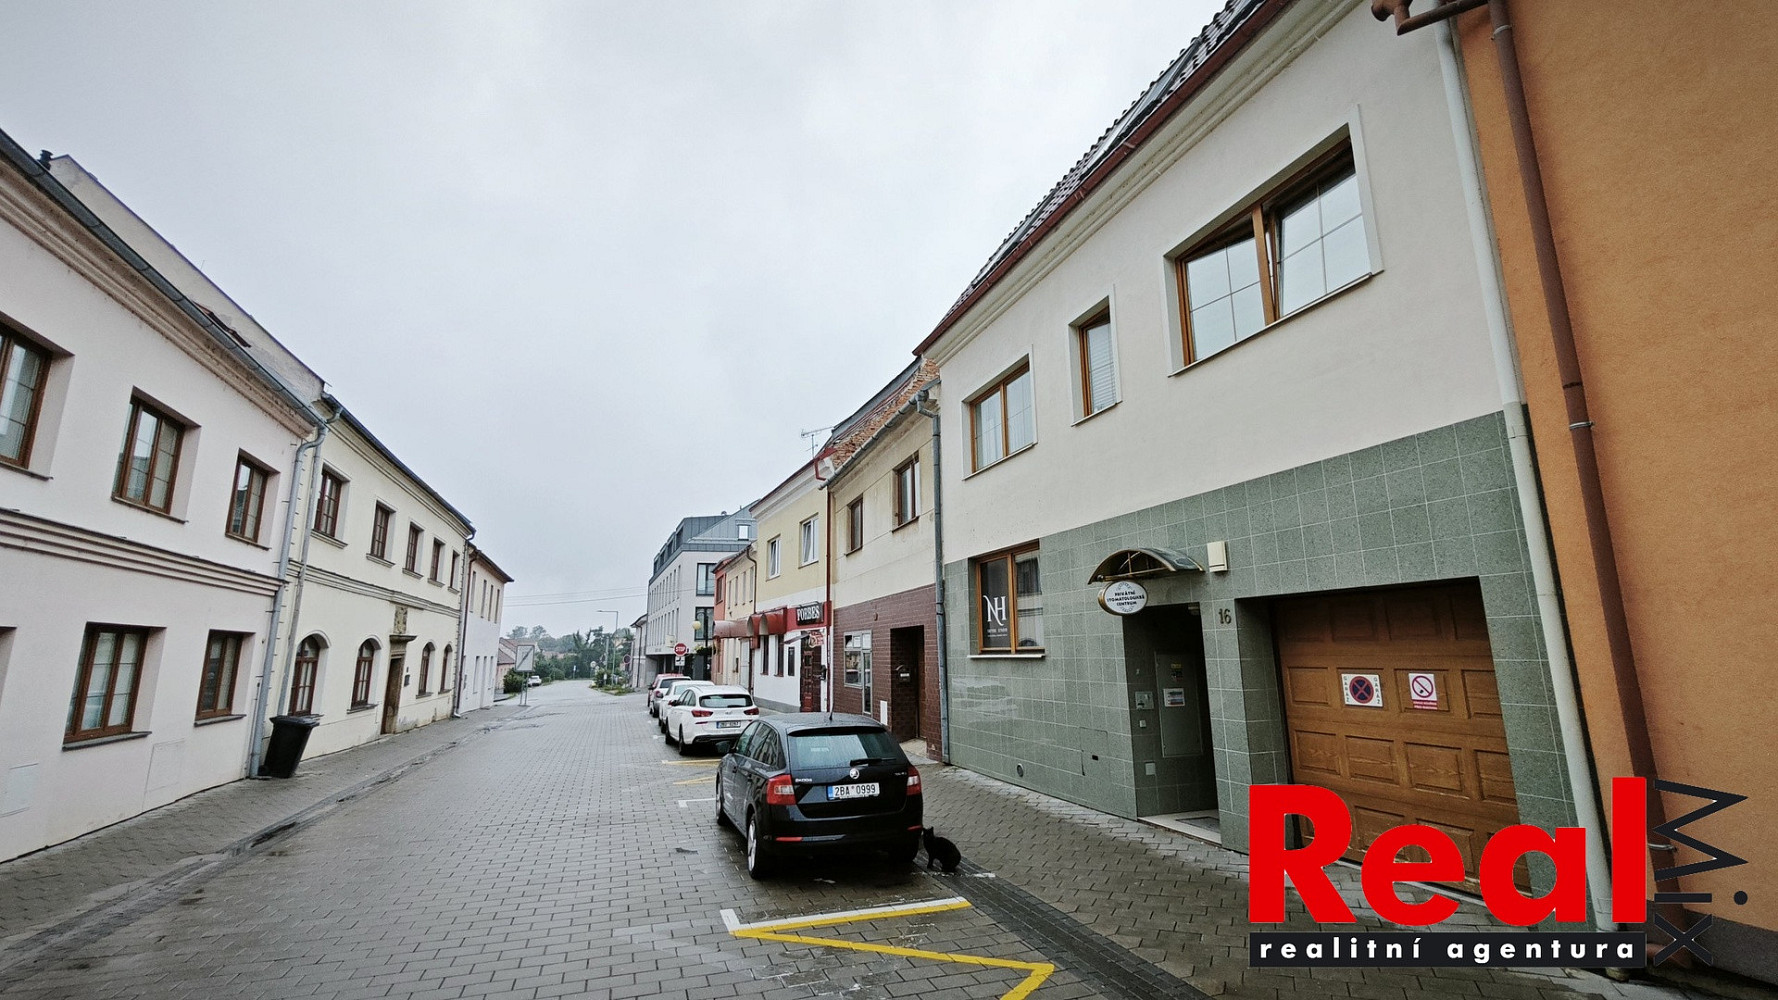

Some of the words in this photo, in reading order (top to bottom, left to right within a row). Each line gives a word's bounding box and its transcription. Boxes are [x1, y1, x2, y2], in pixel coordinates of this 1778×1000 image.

[796, 605, 820, 621] FORBES
[983, 595, 1007, 626] NH
[1218, 608, 1232, 624] 16
[834, 786, 850, 797] 2BA
[855, 784, 876, 795] 0999
